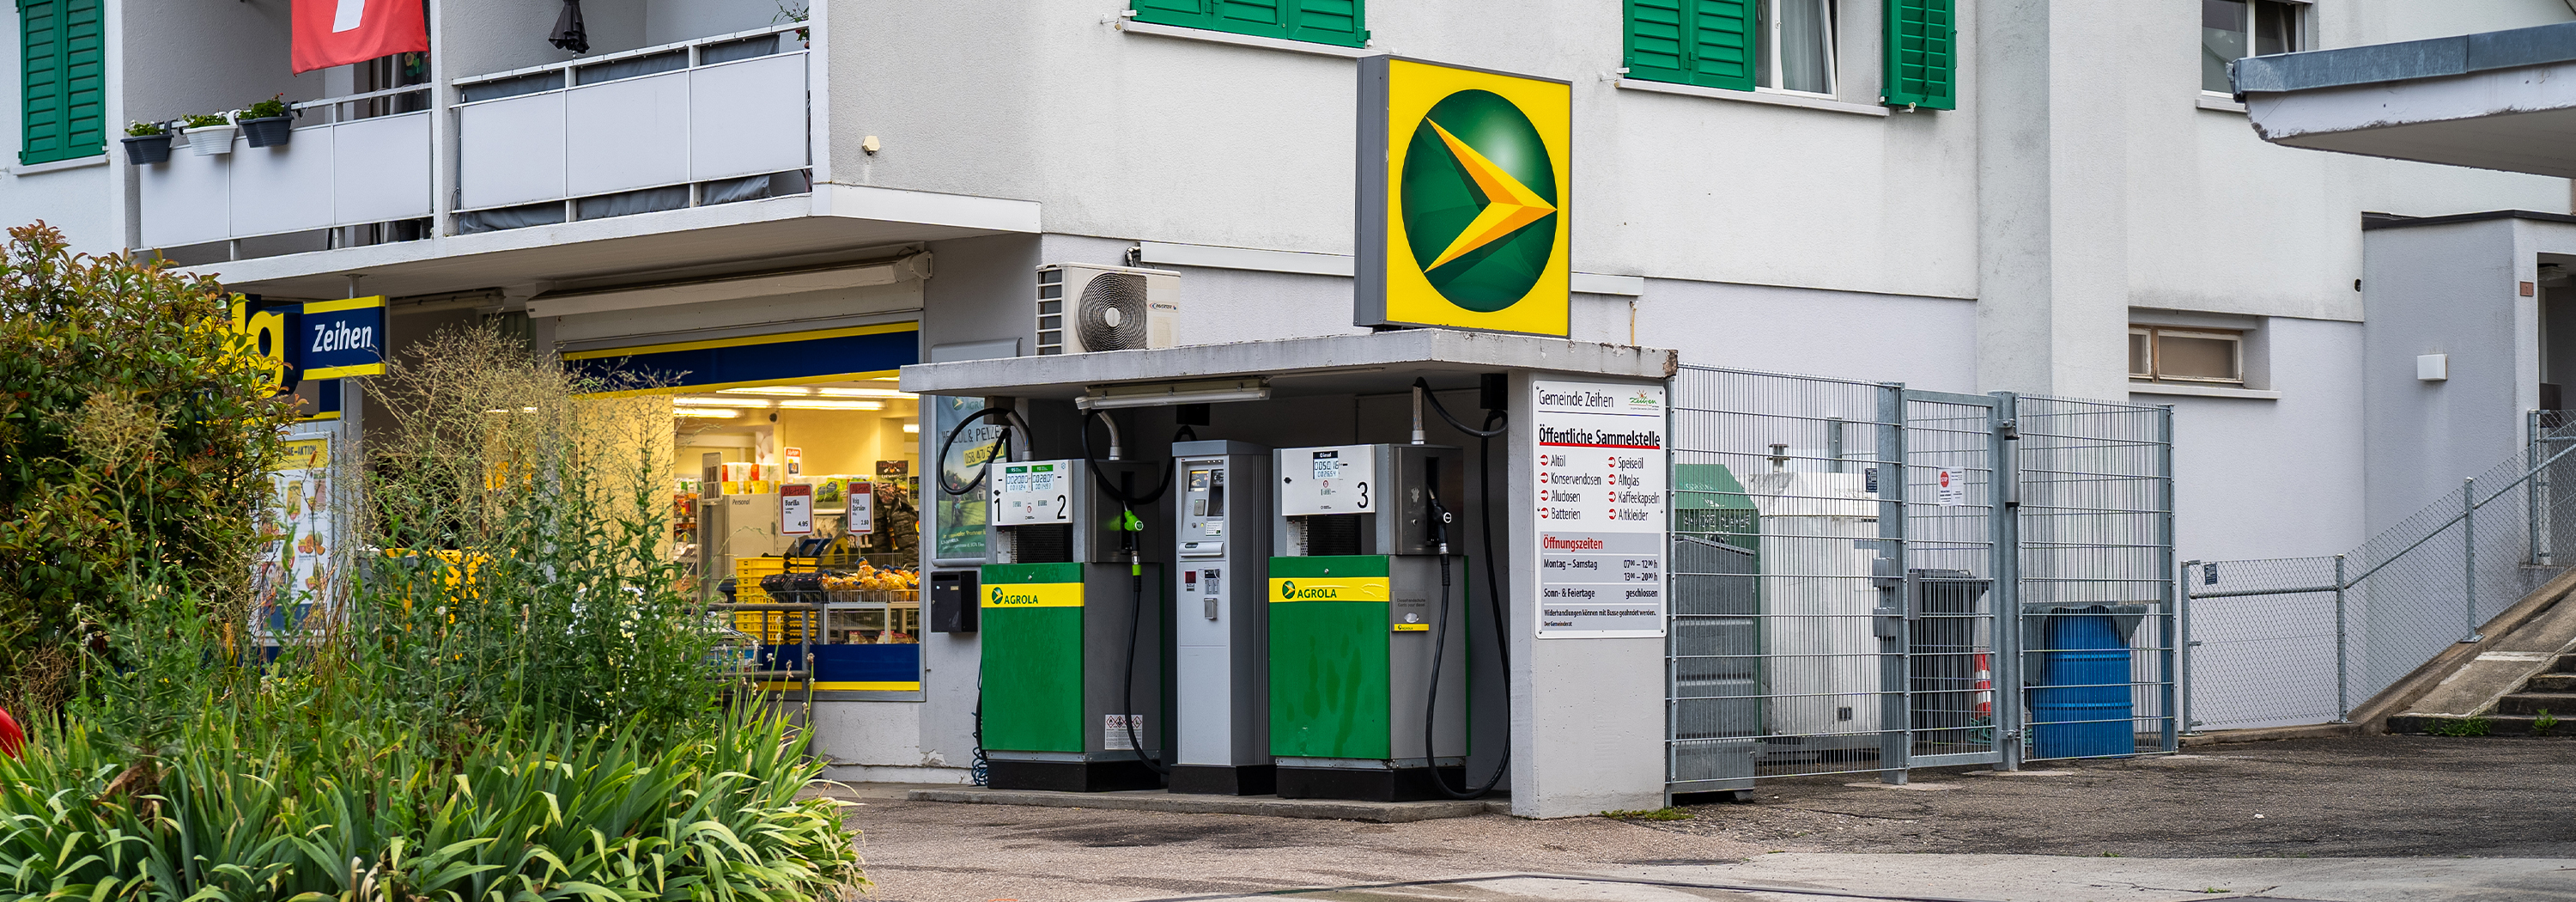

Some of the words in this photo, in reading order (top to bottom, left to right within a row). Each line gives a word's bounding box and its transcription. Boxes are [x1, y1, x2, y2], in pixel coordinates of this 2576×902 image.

[312, 320, 372, 353] Zeihen
[1539, 390, 1583, 406] Gemeinde
[1585, 391, 1613, 408] Zeihen
[967, 429, 974, 443] &
[1539, 424, 1593, 444] Öffentliche
[1595, 430, 1661, 447] Sammelstelle
[1550, 454, 1566, 467] Altöl
[1618, 456, 1643, 472] Speiseöl
[1551, 472, 1601, 485] Konservendosen
[1618, 473, 1640, 490] Altglas
[1357, 481, 1368, 509] 3
[1551, 490, 1581, 503] Aludosen
[1618, 491, 1661, 506] Kaffeekapseln
[993, 497, 1001, 522] 1
[1056, 494, 1066, 520] 2
[1551, 507, 1581, 520] Batterien
[1618, 508, 1649, 521] Altkleider
[1543, 534, 1603, 552] Öffnungszeiten
[1543, 558, 1566, 570] Montag
[1572, 559, 1598, 570] Samstag
[1004, 594, 1039, 605] AGROLA
[1297, 588, 1337, 599] AGROLA
[1543, 588, 1561, 598] Sonn-
[1561, 588, 1567, 598] &
[1567, 588, 1595, 600] Feiertage
[1625, 588, 1658, 600] geschlossen
[1543, 609, 1583, 619] Widerhandlungen
[1582, 608, 1599, 617] können
